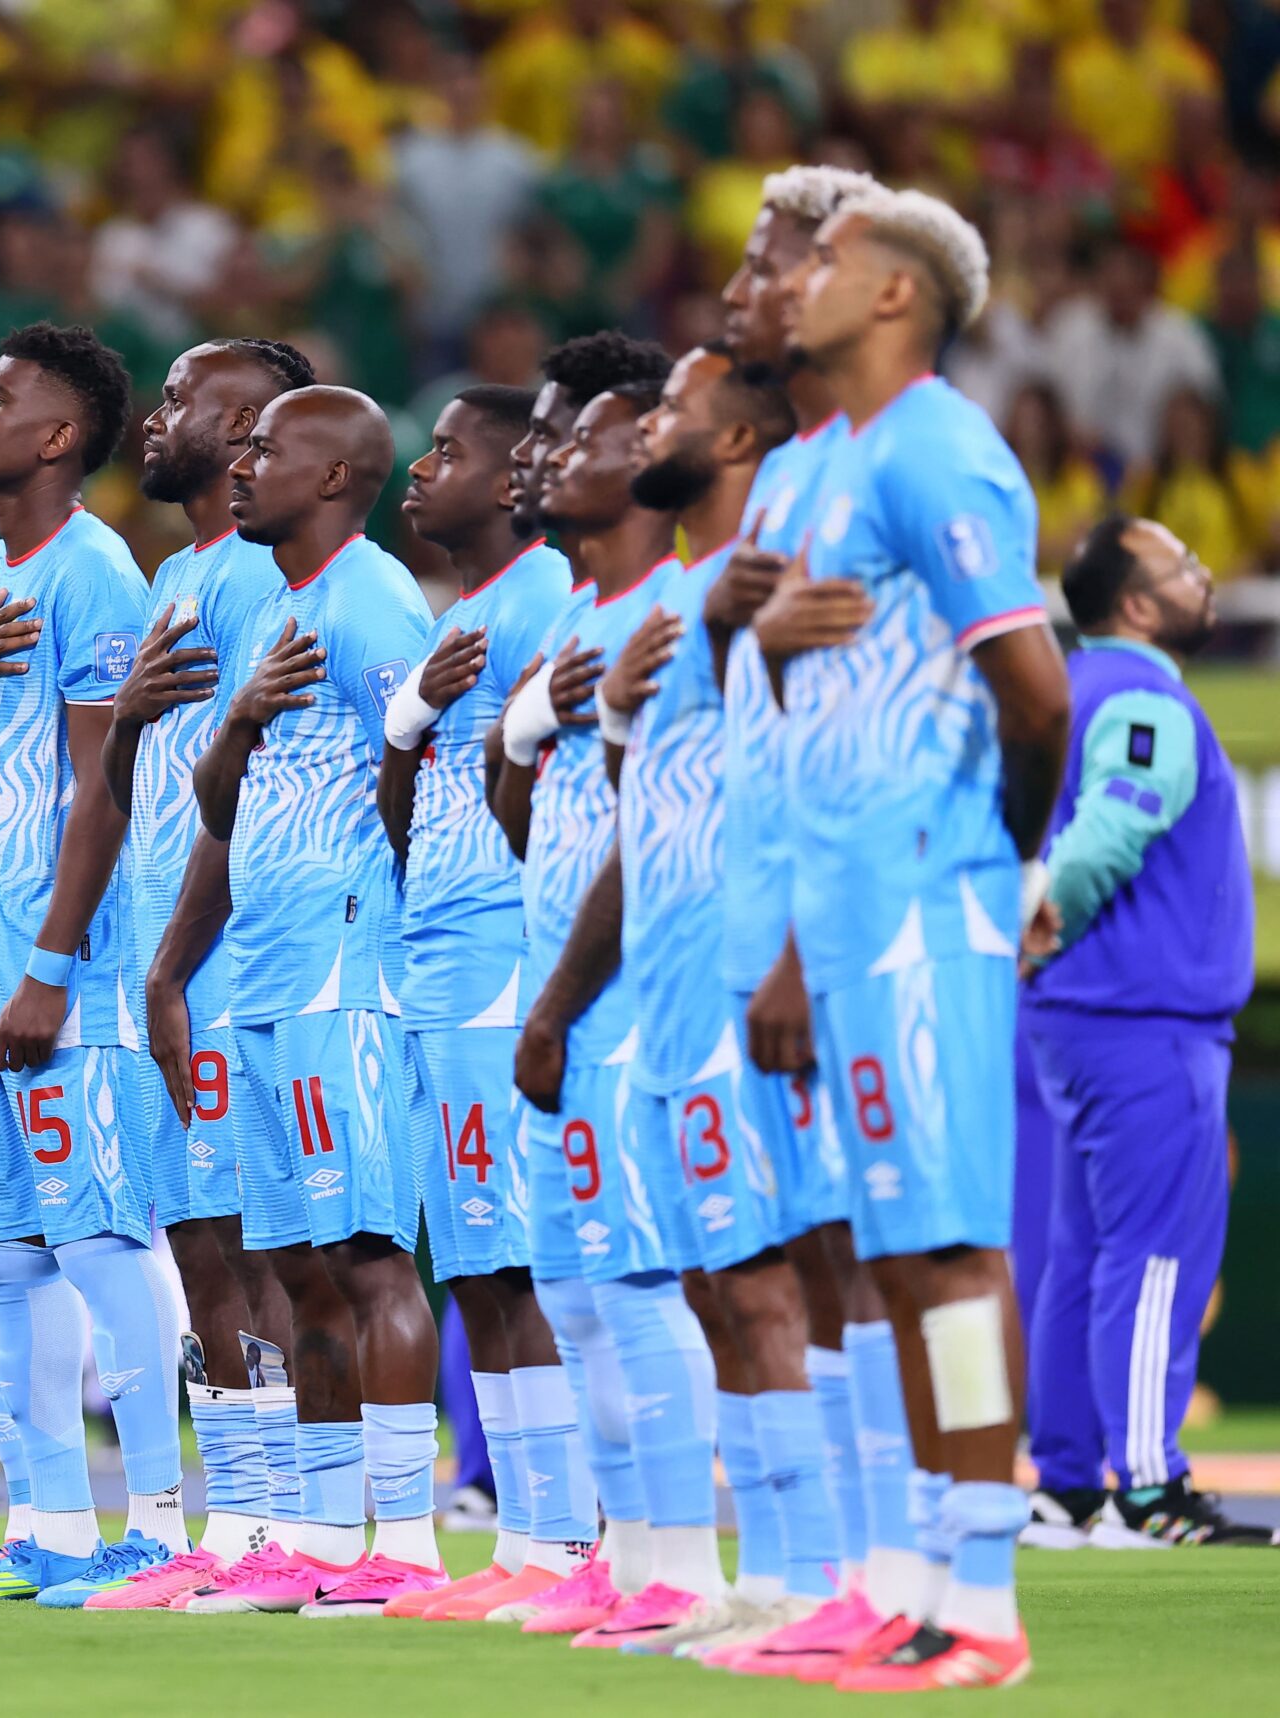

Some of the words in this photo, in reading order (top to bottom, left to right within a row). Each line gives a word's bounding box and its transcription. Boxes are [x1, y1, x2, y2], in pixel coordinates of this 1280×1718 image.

[188, 1050, 230, 1122] 9
[292, 1075, 336, 1157] 11
[850, 1055, 895, 1142] 8
[441, 1102, 494, 1185] 14
[563, 1118, 601, 1202] 9
[40, 1196, 68, 1206] umbro
[311, 1186, 344, 1201] umbro
[156, 1498, 181, 1508] umb
